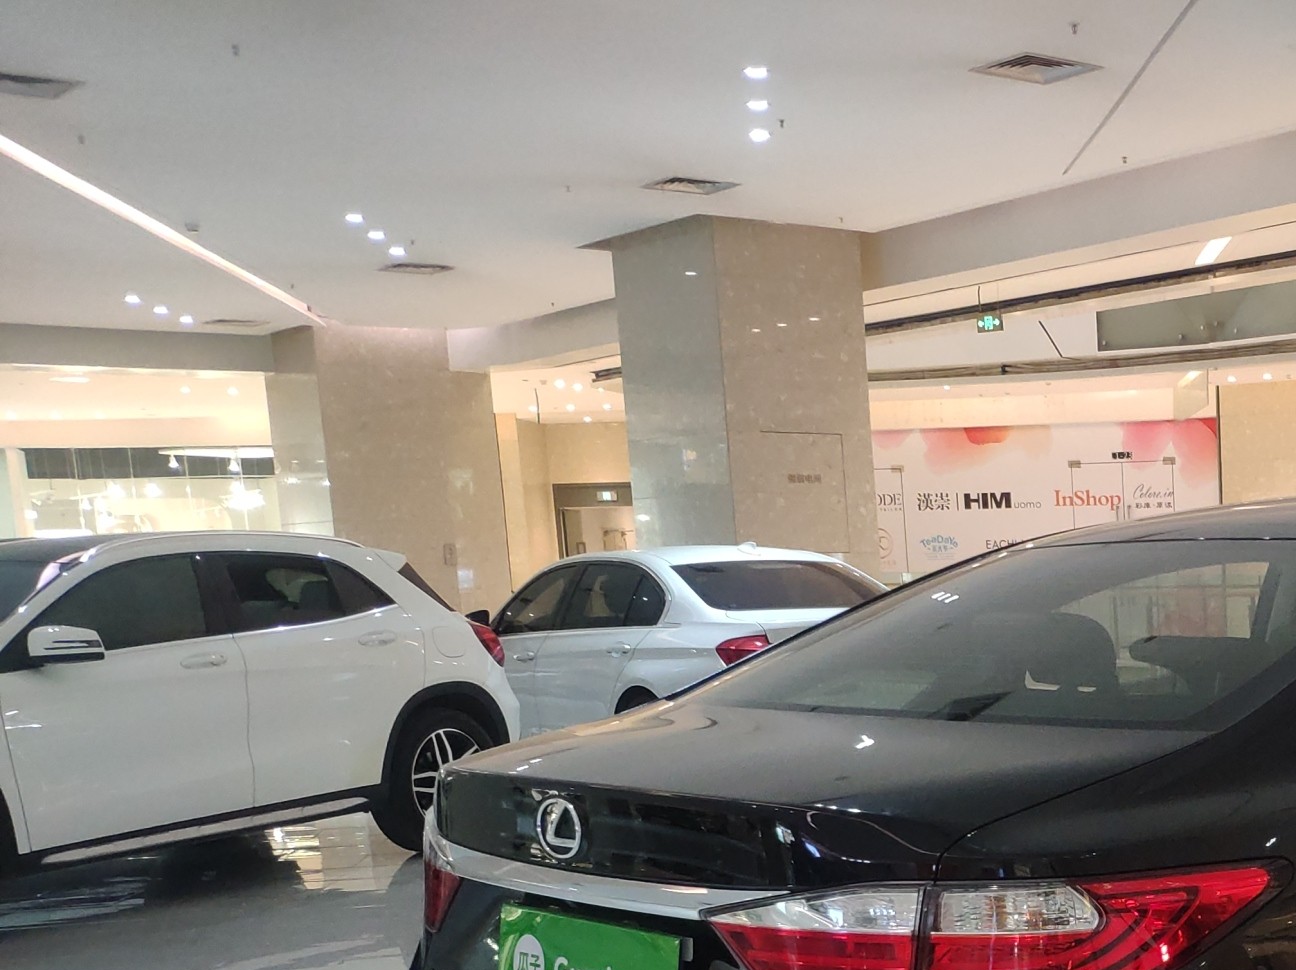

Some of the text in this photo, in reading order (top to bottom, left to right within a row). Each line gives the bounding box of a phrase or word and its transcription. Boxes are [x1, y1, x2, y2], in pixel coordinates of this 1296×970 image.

[963, 492, 1012, 510] HIM
[1014, 499, 1042, 509] uomo
[1054, 489, 1121, 511] InShop
